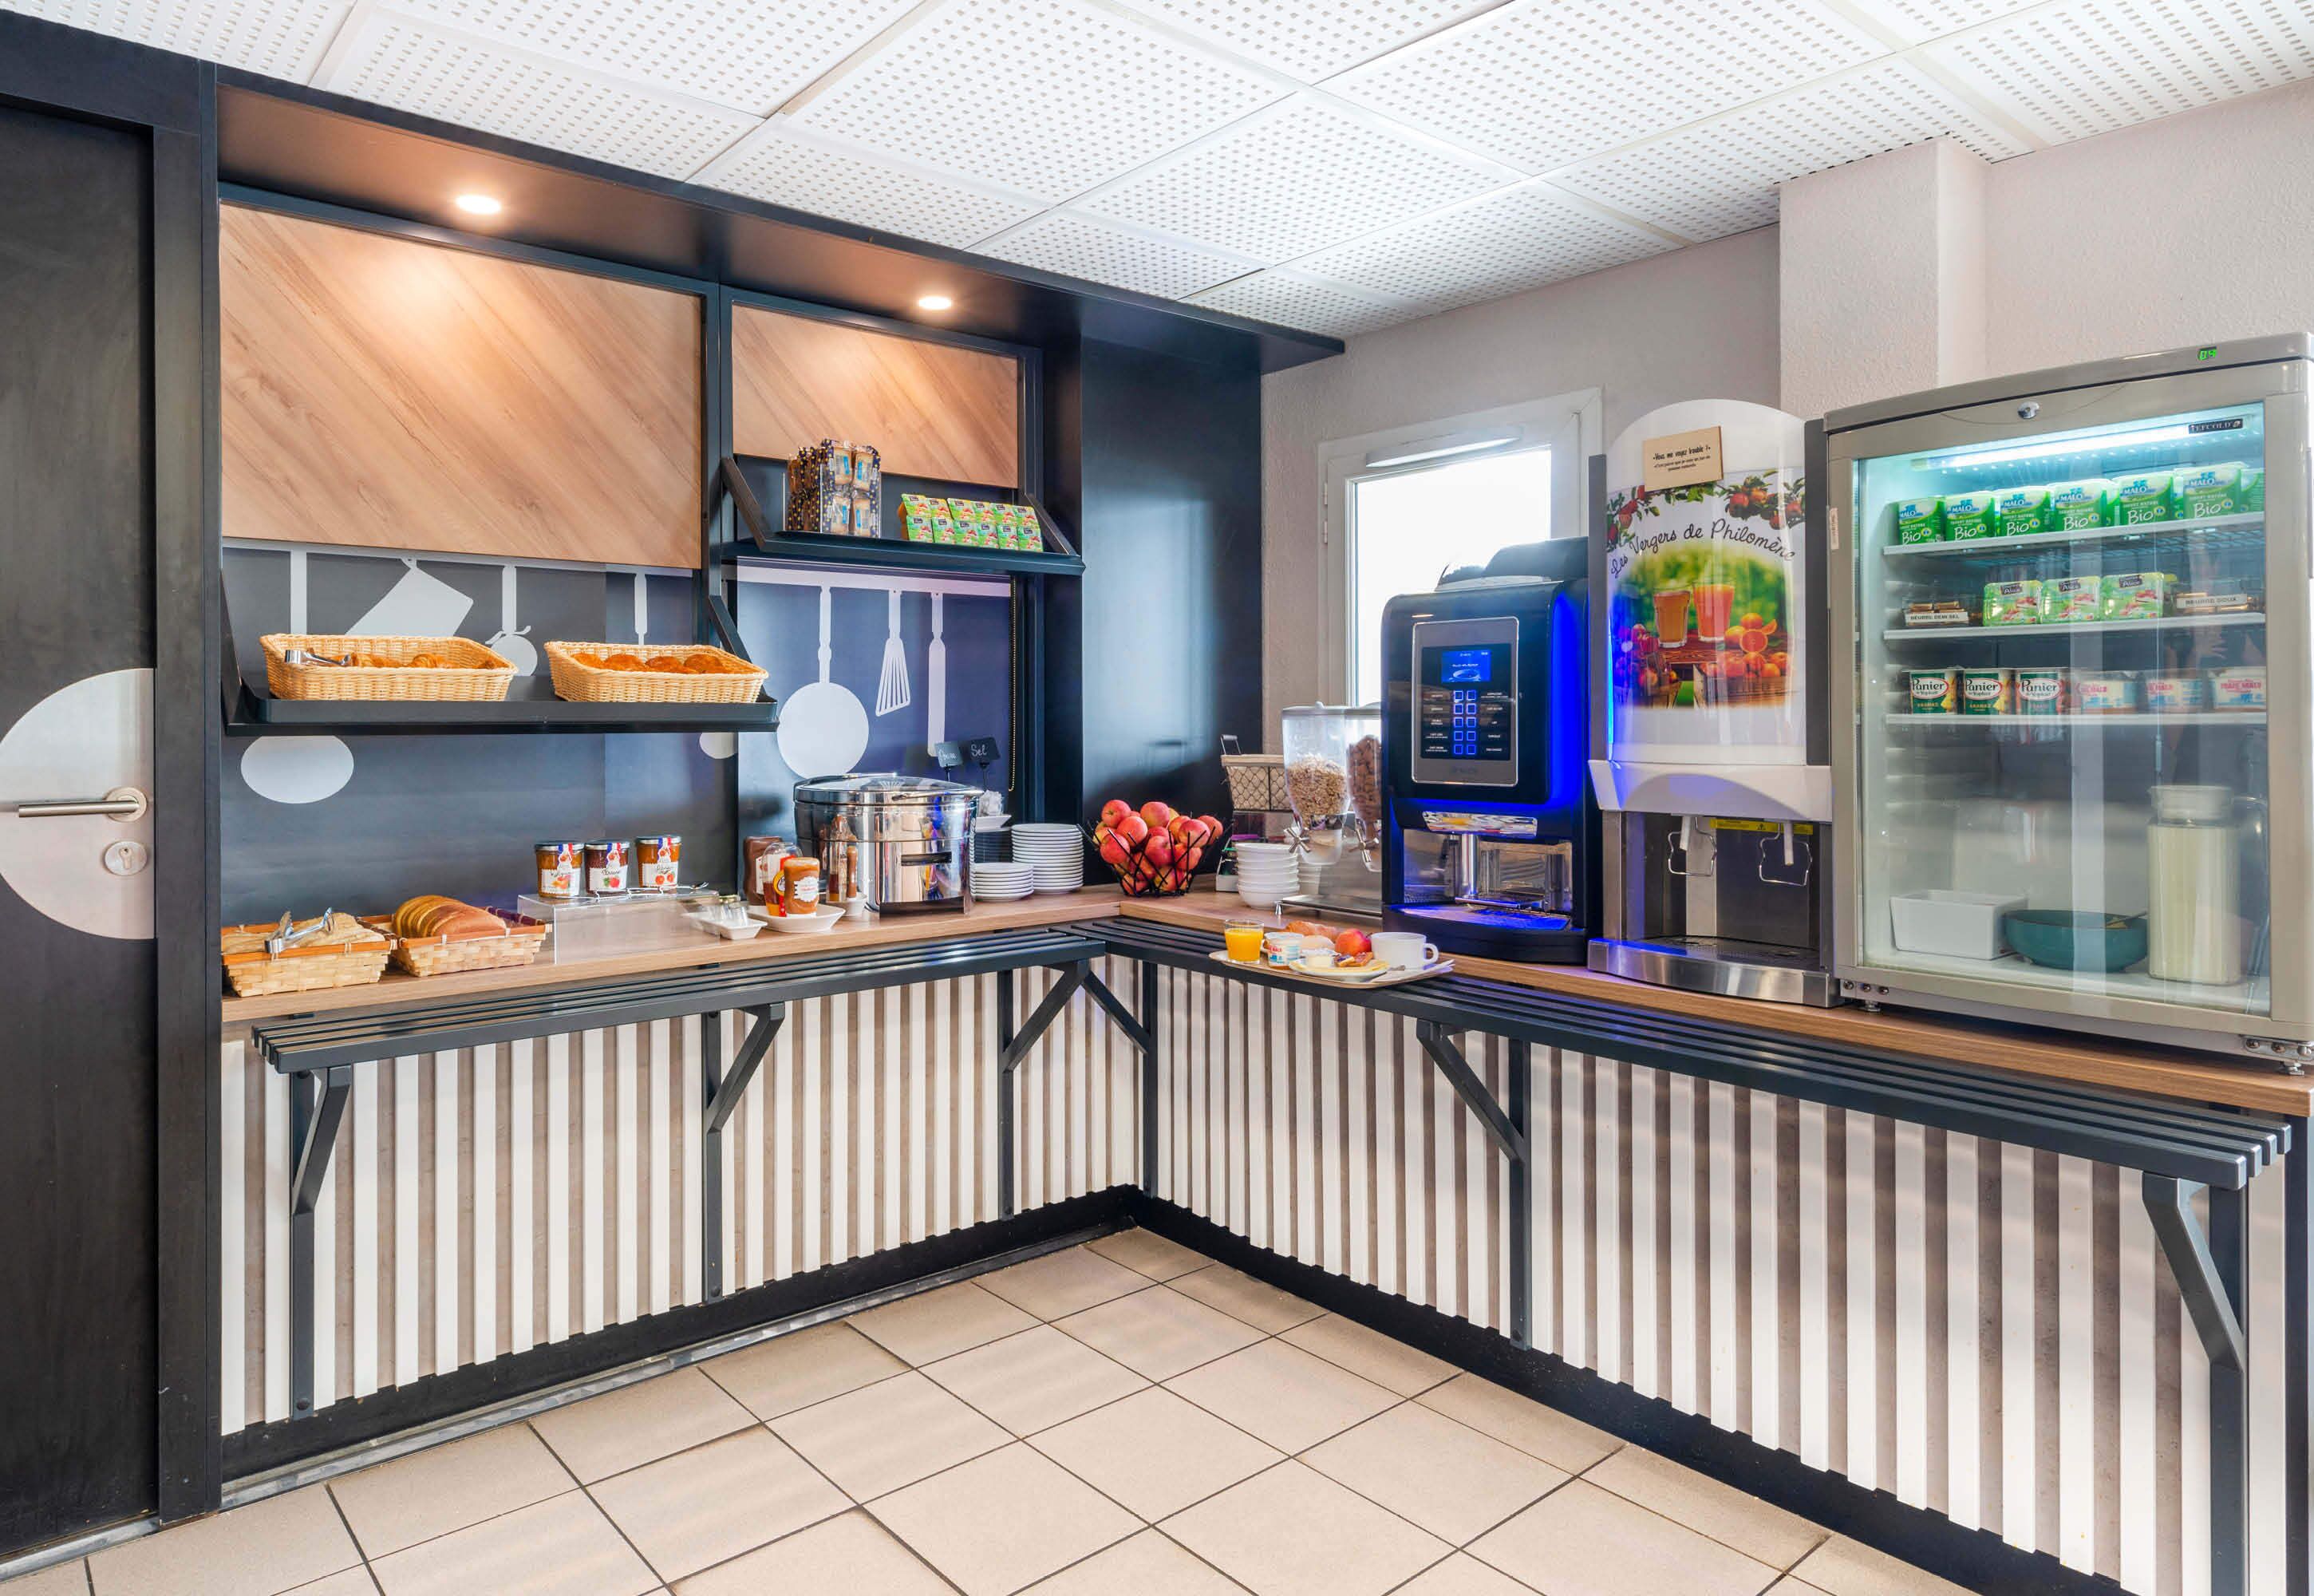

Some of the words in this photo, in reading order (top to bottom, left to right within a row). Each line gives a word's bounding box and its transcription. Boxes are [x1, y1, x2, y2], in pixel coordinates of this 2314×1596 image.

[2190, 477, 2215, 487] MALO
[2060, 492, 2083, 501] MALO
[2124, 485, 2147, 495] MALO
[2127, 508, 2154, 524] Bio
[2194, 503, 2221, 519] Bio
[2006, 522, 2030, 536] Bio
[2063, 516, 2088, 531] Bio
[1902, 531, 1921, 545] Bio
[1954, 527, 1977, 541] Bio
[1610, 555, 1629, 579] Les
[1629, 529, 1677, 554] Vergers
[1684, 523, 1704, 539] de
[1710, 518, 1796, 561] Philomène
[1912, 678, 1945, 691] Panier
[1965, 678, 1998, 692] Panier
[2021, 679, 2057, 692] Panier
[970, 744, 987, 757] Sel
